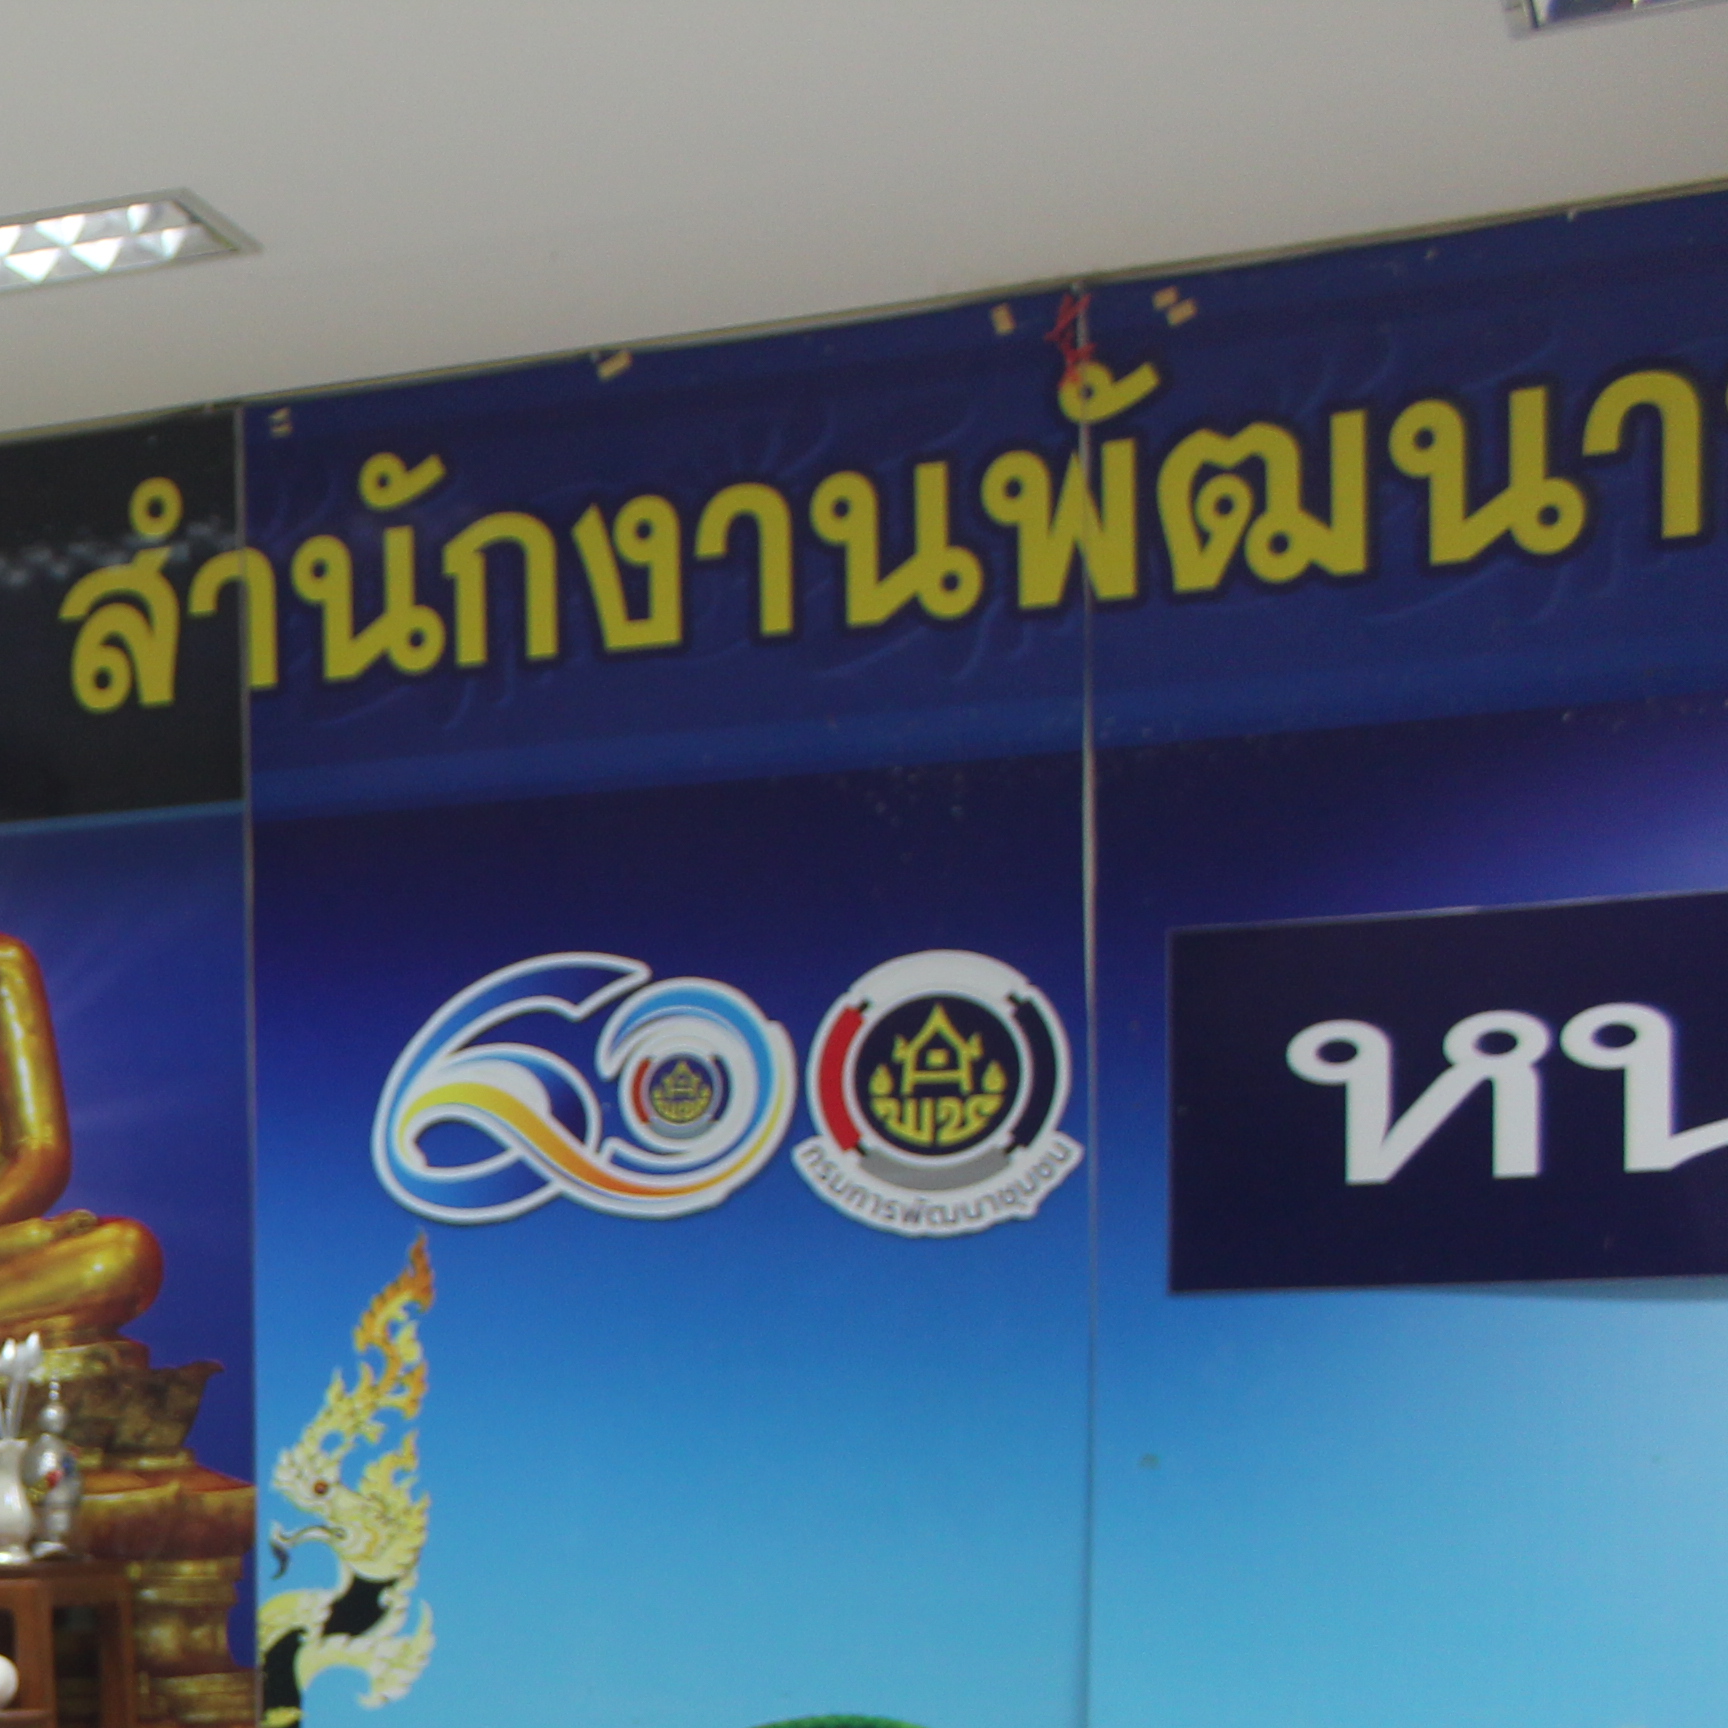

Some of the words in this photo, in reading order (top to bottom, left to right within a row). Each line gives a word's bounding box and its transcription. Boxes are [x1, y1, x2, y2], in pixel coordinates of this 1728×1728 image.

[58, 358, 1728, 714] สำนักงานพัฒนา
[801, 1140, 1074, 1228] กรมการพัฒนาชุมชน
